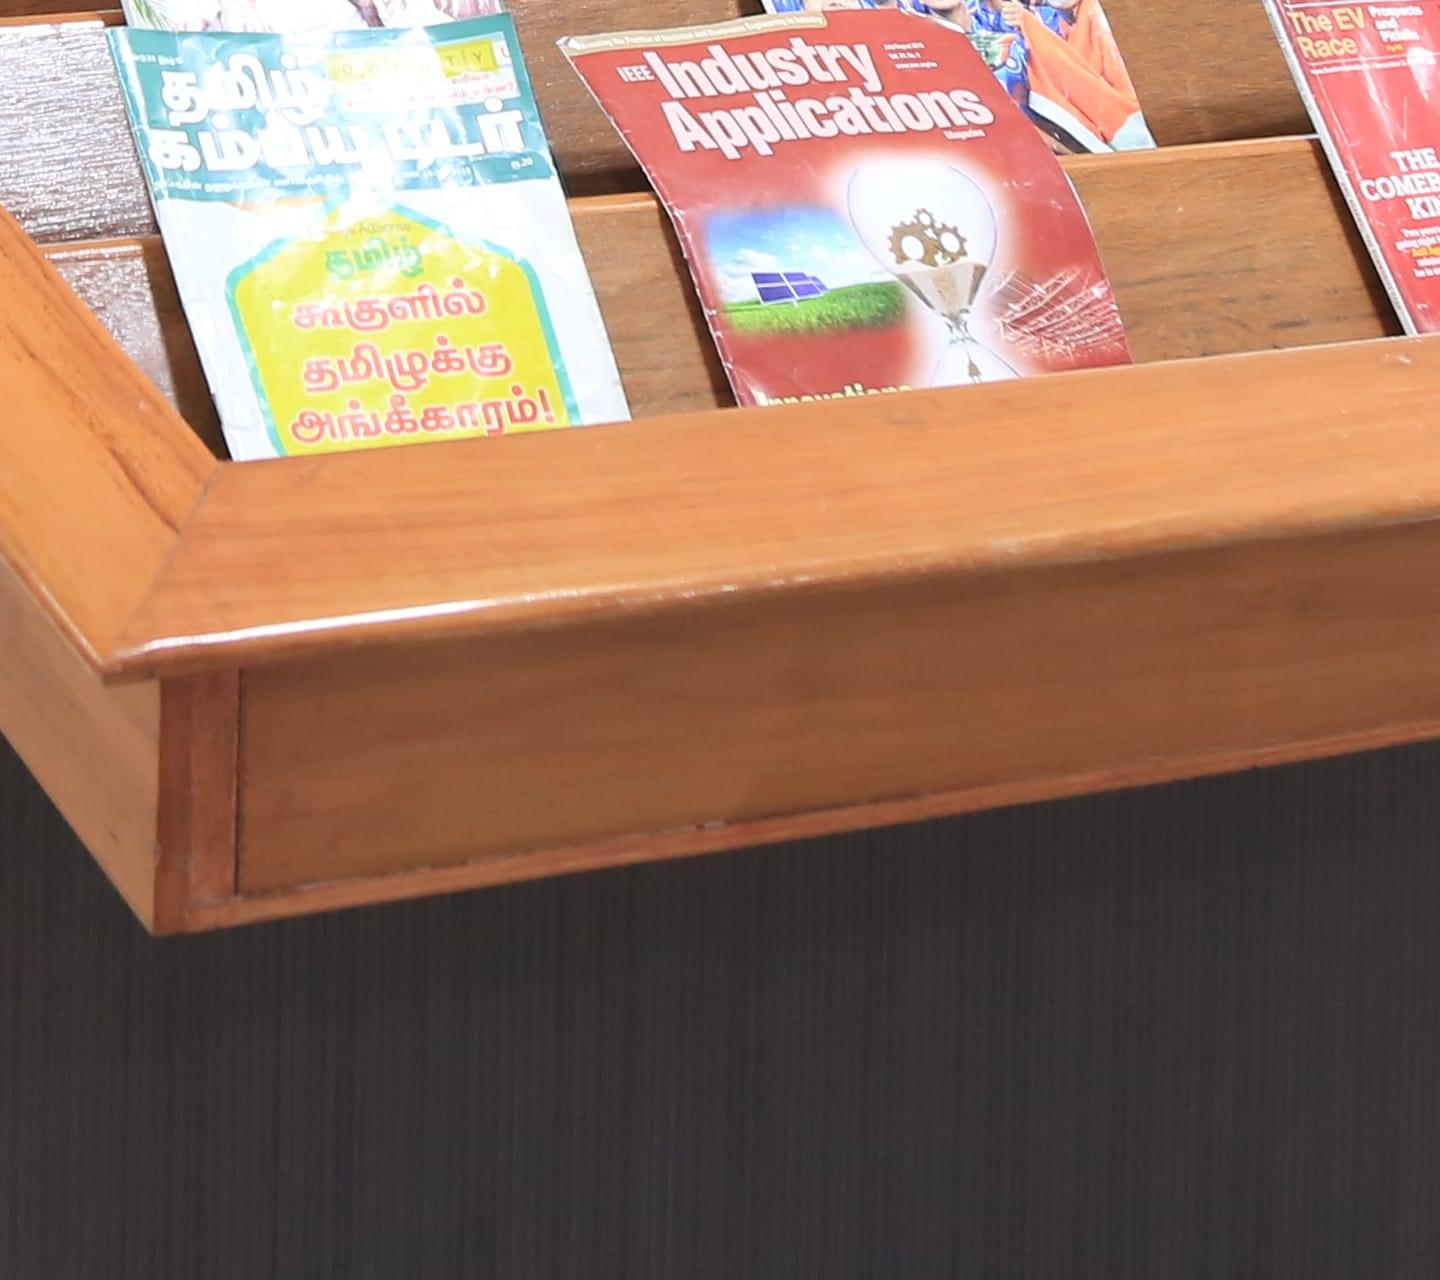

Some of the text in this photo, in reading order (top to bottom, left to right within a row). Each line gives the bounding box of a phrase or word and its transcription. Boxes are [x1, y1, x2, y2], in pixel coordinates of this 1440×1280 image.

[1287, 6, 1366, 36] The EV
[1367, 5, 1424, 18] Prospects
[1375, 16, 1399, 30] and
[616, 36, 884, 100] IEEE Industry
[1296, 35, 1359, 60] Race
[160, 52, 324, 127] தமிழ்
[660, 85, 996, 161] Applications
[942, 129, 987, 141] Magazine
[325, 236, 424, 279] தமிழ்
[293, 278, 486, 332] கூகுளில்
[304, 335, 513, 393] தமிழுக்கு
[291, 385, 556, 445] அங்கீகாரம்!
